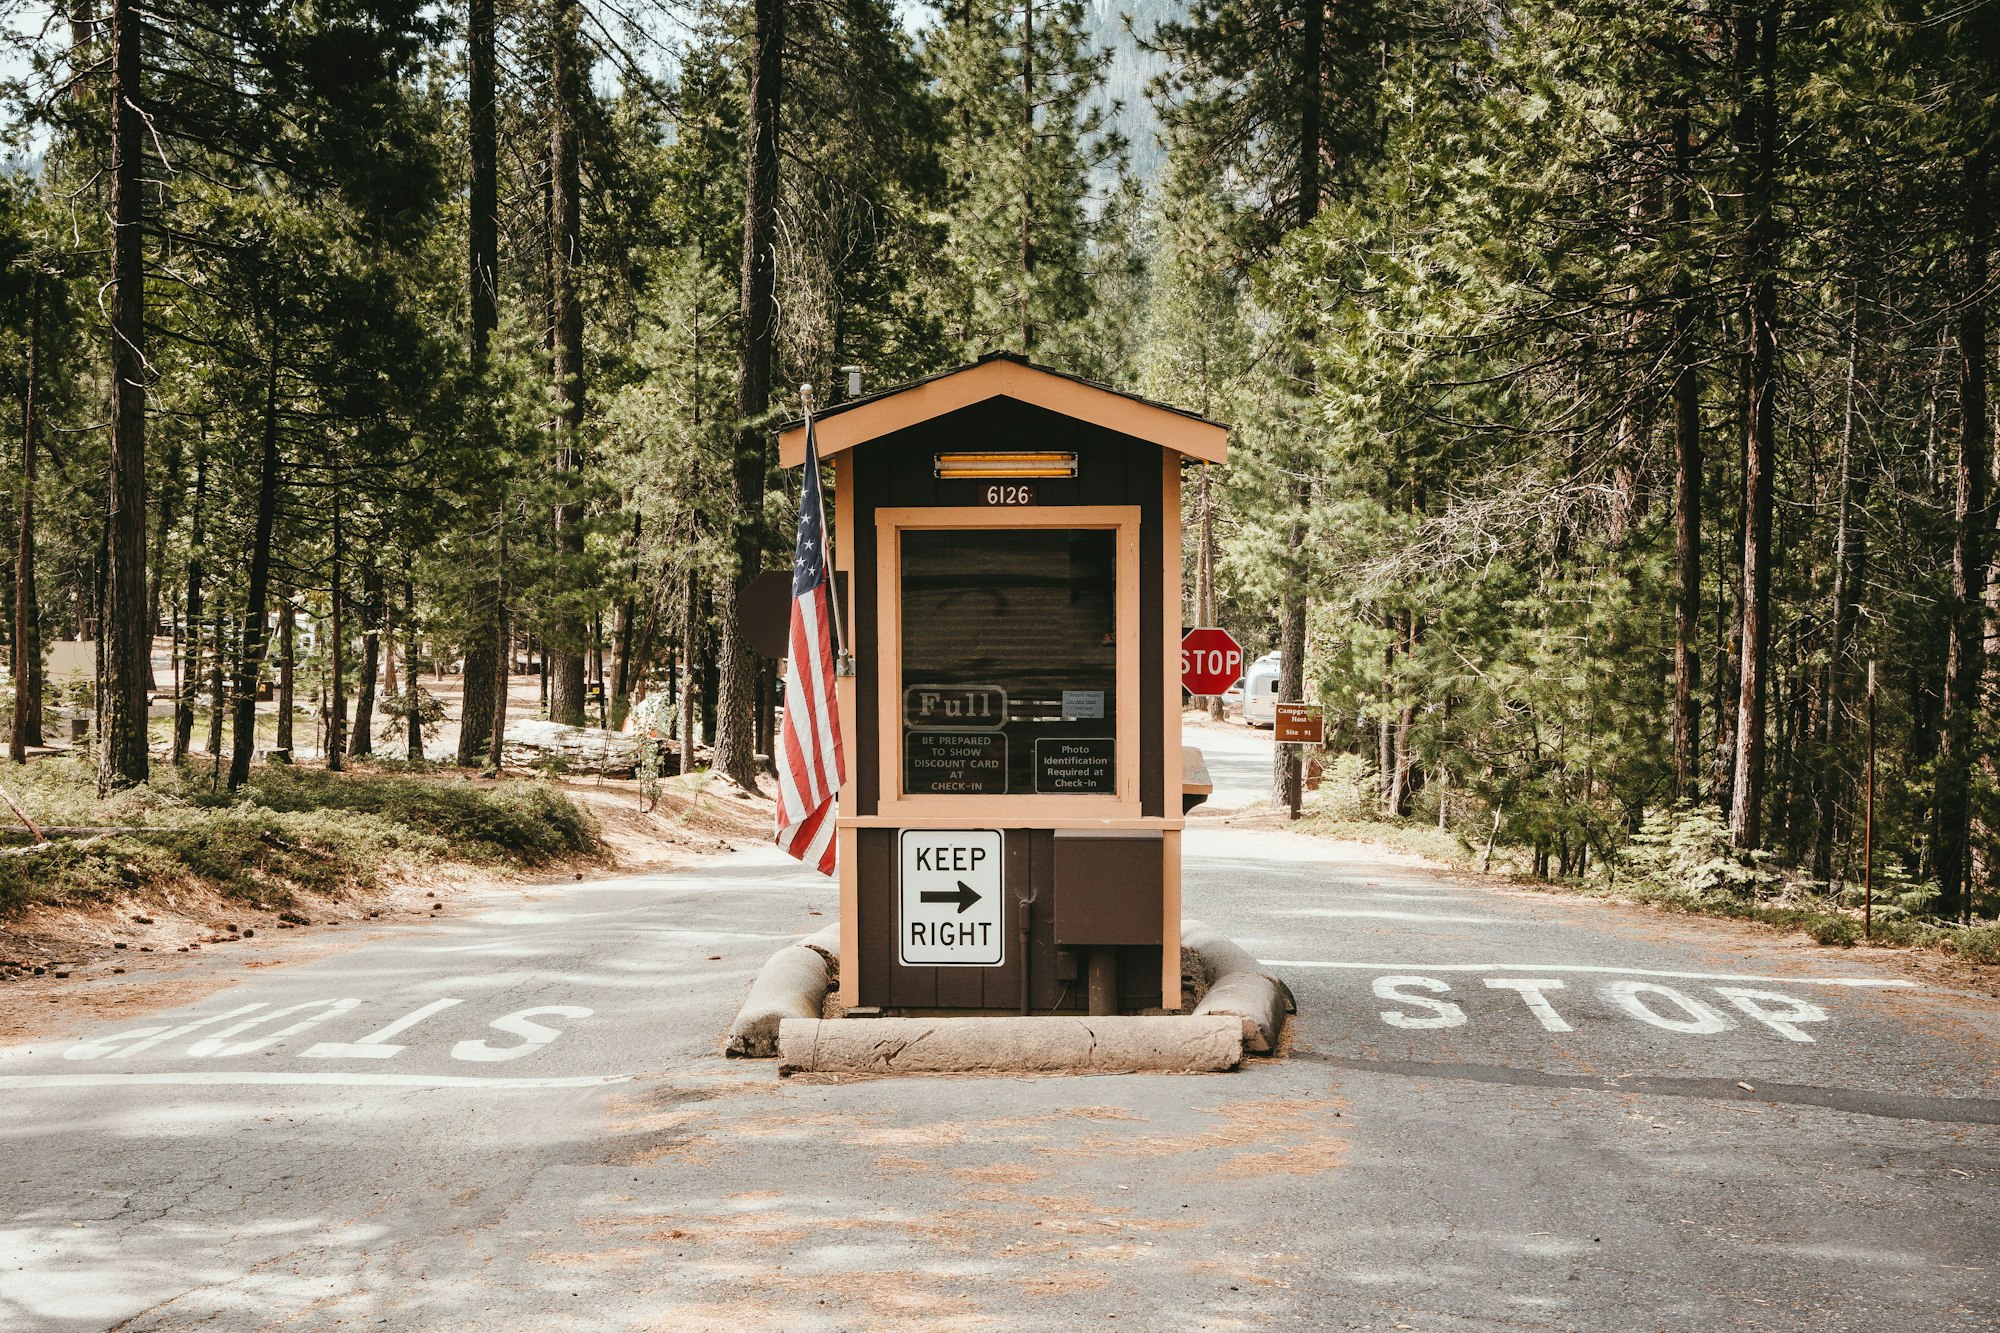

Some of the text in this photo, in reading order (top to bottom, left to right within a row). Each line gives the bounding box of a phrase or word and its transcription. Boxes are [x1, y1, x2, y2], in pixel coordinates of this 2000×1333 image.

[987, 485, 1029, 504] 6126
[1182, 650, 1241, 675] STOP
[919, 692, 992, 717] Full
[922, 736, 991, 745] BE PREPARED
[932, 748, 982, 757] TO SHOW
[1061, 745, 1090, 754] Photo
[914, 759, 999, 768] DISCOUNT CARD
[1043, 756, 1108, 765] Identification
[949, 771, 963, 779] AT
[1047, 768, 1104, 778] Required at
[931, 782, 982, 791] CHECK-IN
[1055, 779, 1097, 787] Check-In
[916, 847, 986, 871] KEEP
[911, 922, 992, 946] RIGHT
[1372, 975, 1829, 1043] STOP
[63, 998, 595, 1062] STOP
